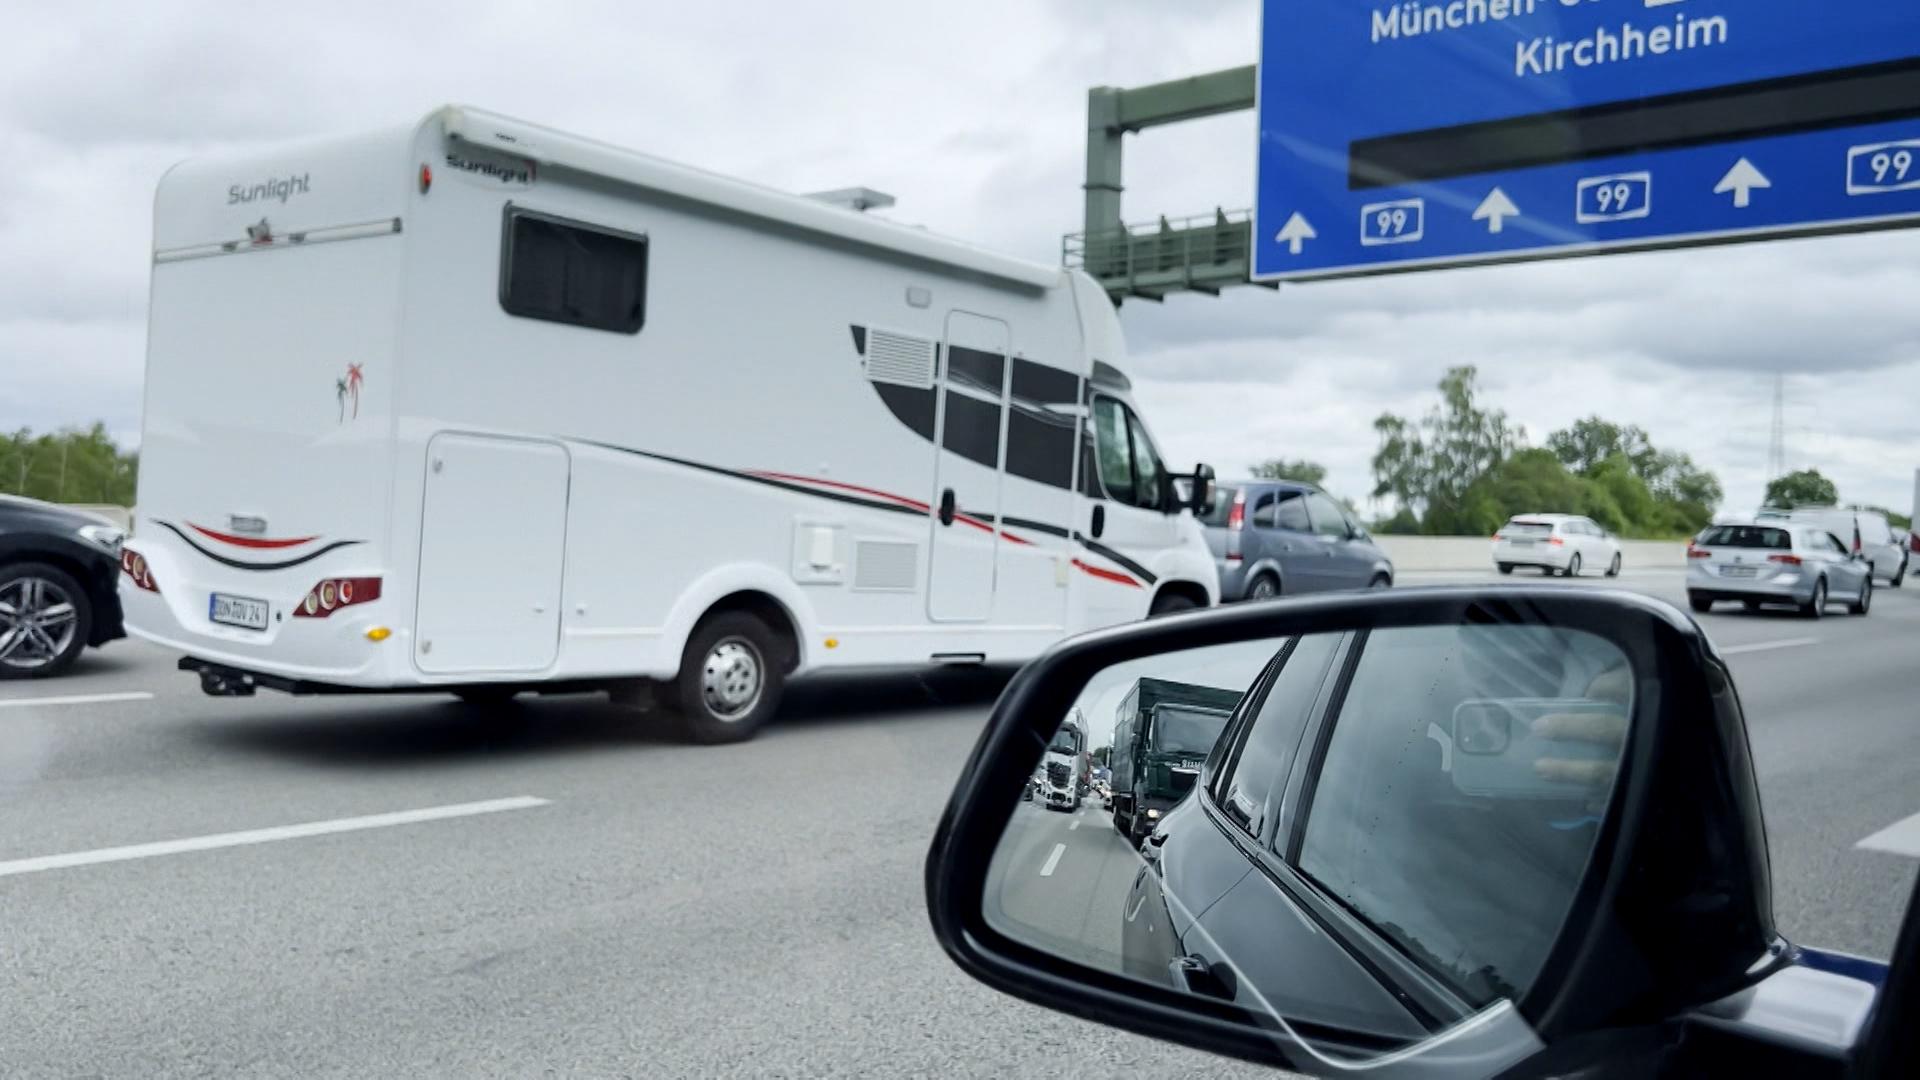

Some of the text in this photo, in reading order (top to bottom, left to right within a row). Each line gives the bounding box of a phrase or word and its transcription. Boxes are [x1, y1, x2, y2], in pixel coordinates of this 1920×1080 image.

[1515, 12, 1728, 77] Kirchheim
[1871, 149, 1913, 183] 99
[226, 171, 311, 206] Sunlight
[1596, 182, 1631, 212] 99
[1376, 208, 1408, 236] 99
